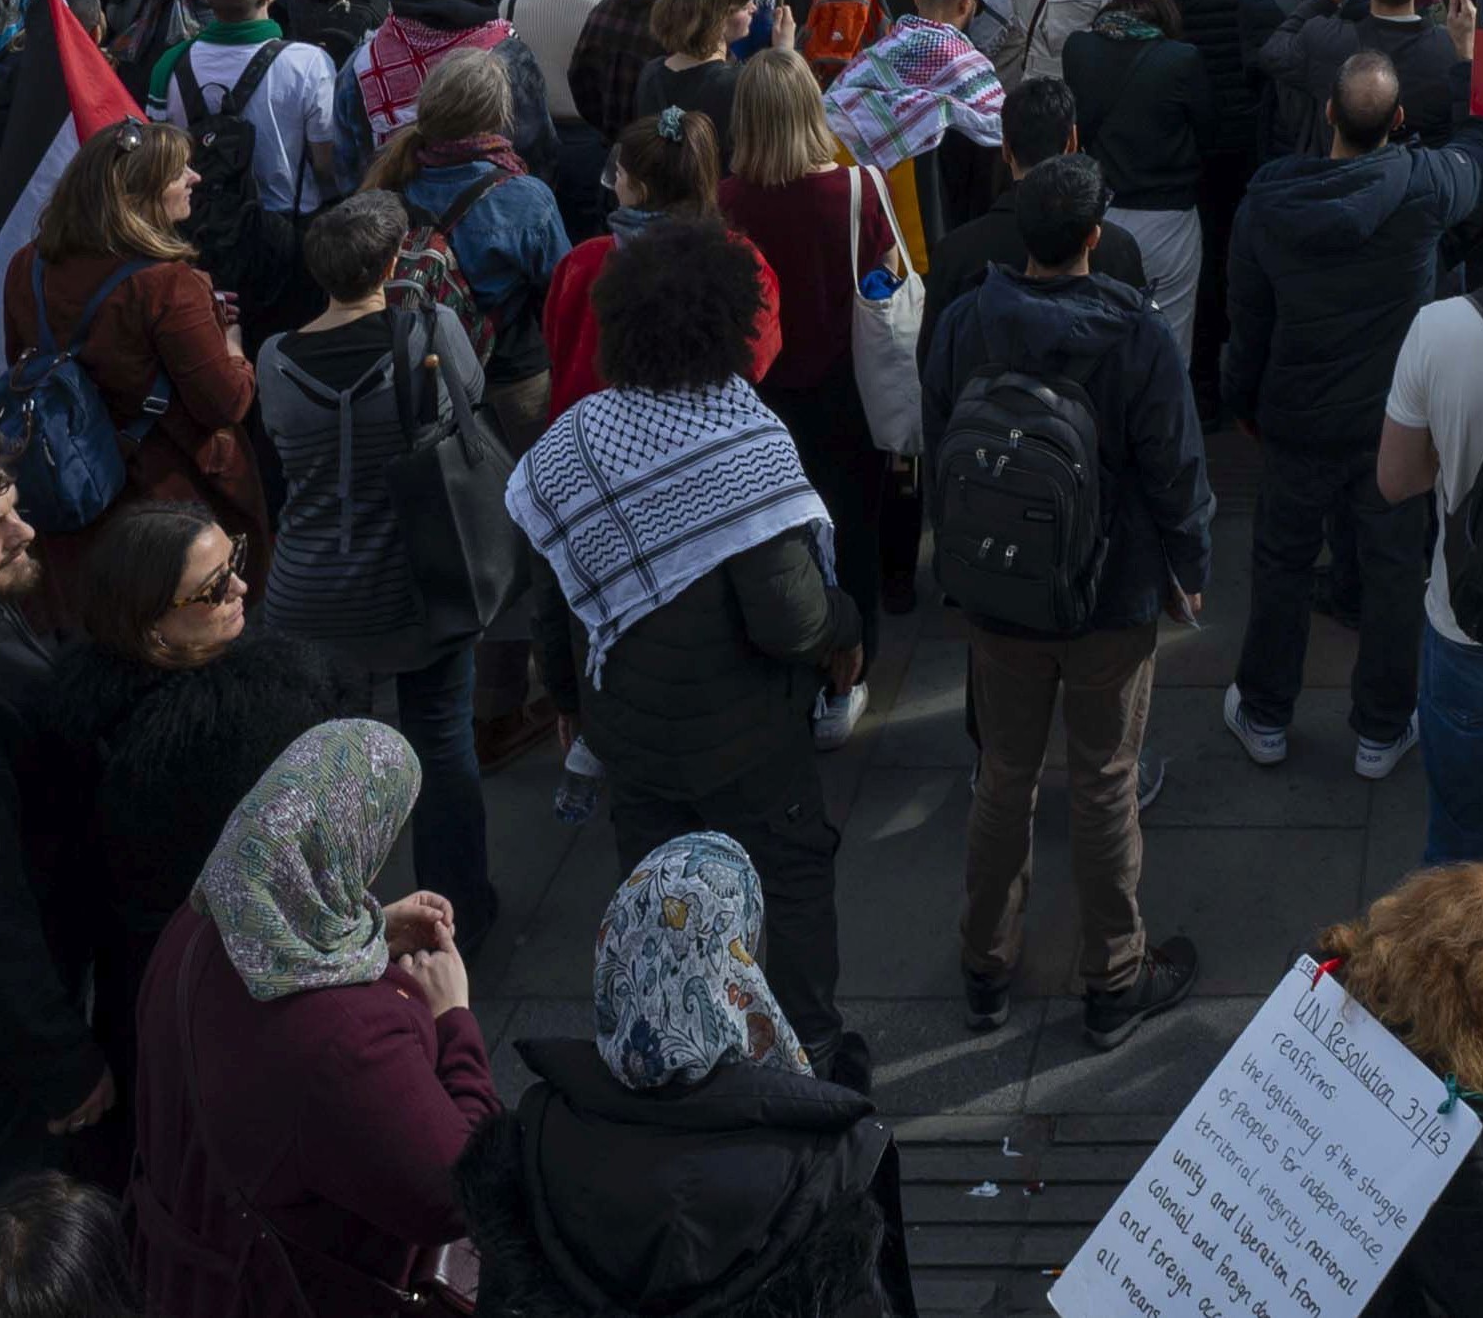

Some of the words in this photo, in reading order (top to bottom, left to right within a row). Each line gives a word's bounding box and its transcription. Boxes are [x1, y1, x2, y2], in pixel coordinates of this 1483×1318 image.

[1241, 1051, 1263, 1083] the
[1261, 1075, 1323, 1157] legitimacy
[1325, 1143, 1341, 1163] of
[1339, 1153, 1357, 1181] the
[1357, 1174, 1408, 1231] struggle
[1293, 991, 1328, 1035] UN
[1325, 1023, 1393, 1109] Resolution
[1402, 1097, 1453, 1157] 37/43
[1119, 1209, 1147, 1245] and
[1147, 1239, 1193, 1299] foreign
[1171, 1149, 1208, 1199] unity
[1210, 1191, 1237, 1223] and
[1233, 1211, 1289, 1287] liberation
[1291, 1279, 1321, 1318] from
[1195, 1112, 1255, 1187] territorial
[1257, 1181, 1304, 1249] integrity,
[1304, 1238, 1359, 1298] national
[1218, 1087, 1235, 1112] of
[1282, 1147, 1301, 1175] for
[1299, 1168, 1383, 1266] independence,
[1095, 1246, 1120, 1277] all
[1191, 1232, 1216, 1263] and
[1215, 1253, 1252, 1315] foreign
